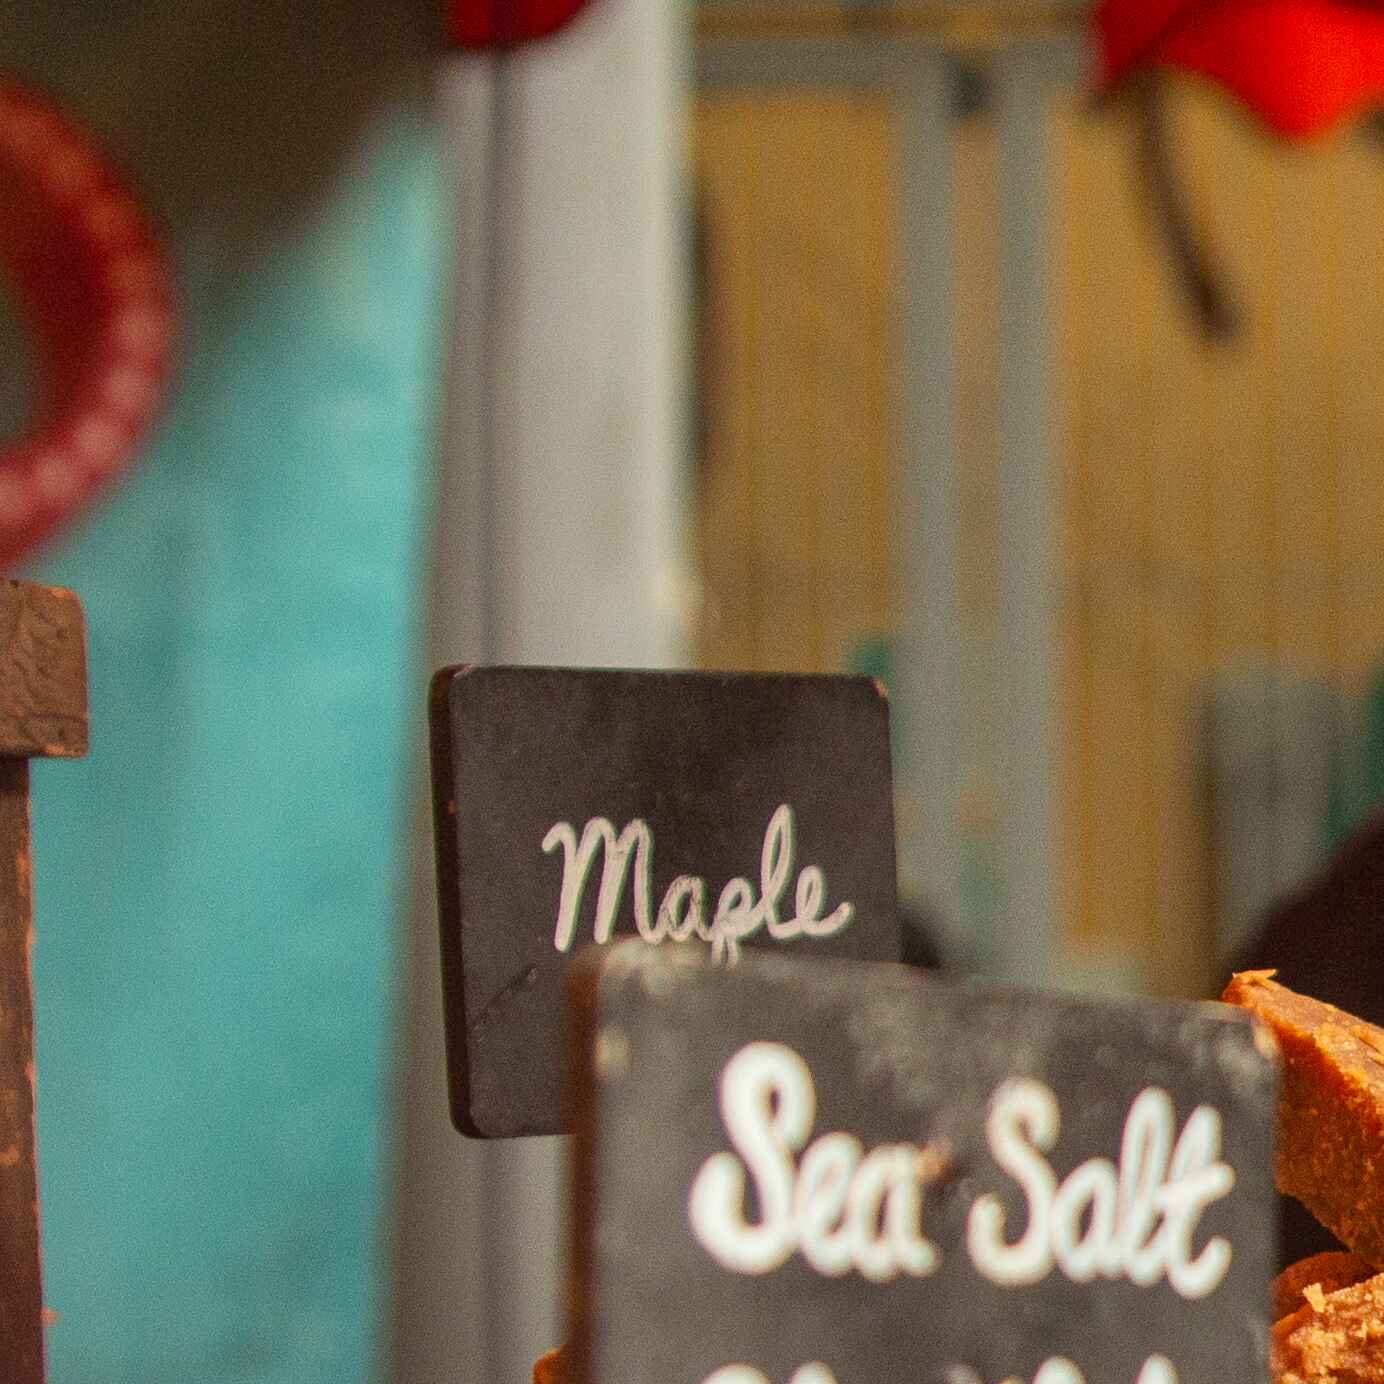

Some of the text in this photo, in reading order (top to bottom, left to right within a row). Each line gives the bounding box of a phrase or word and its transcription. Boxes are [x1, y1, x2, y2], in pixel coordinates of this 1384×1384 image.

[541, 803, 855, 968] Maple
[690, 1041, 1236, 1299] Sea Salt
